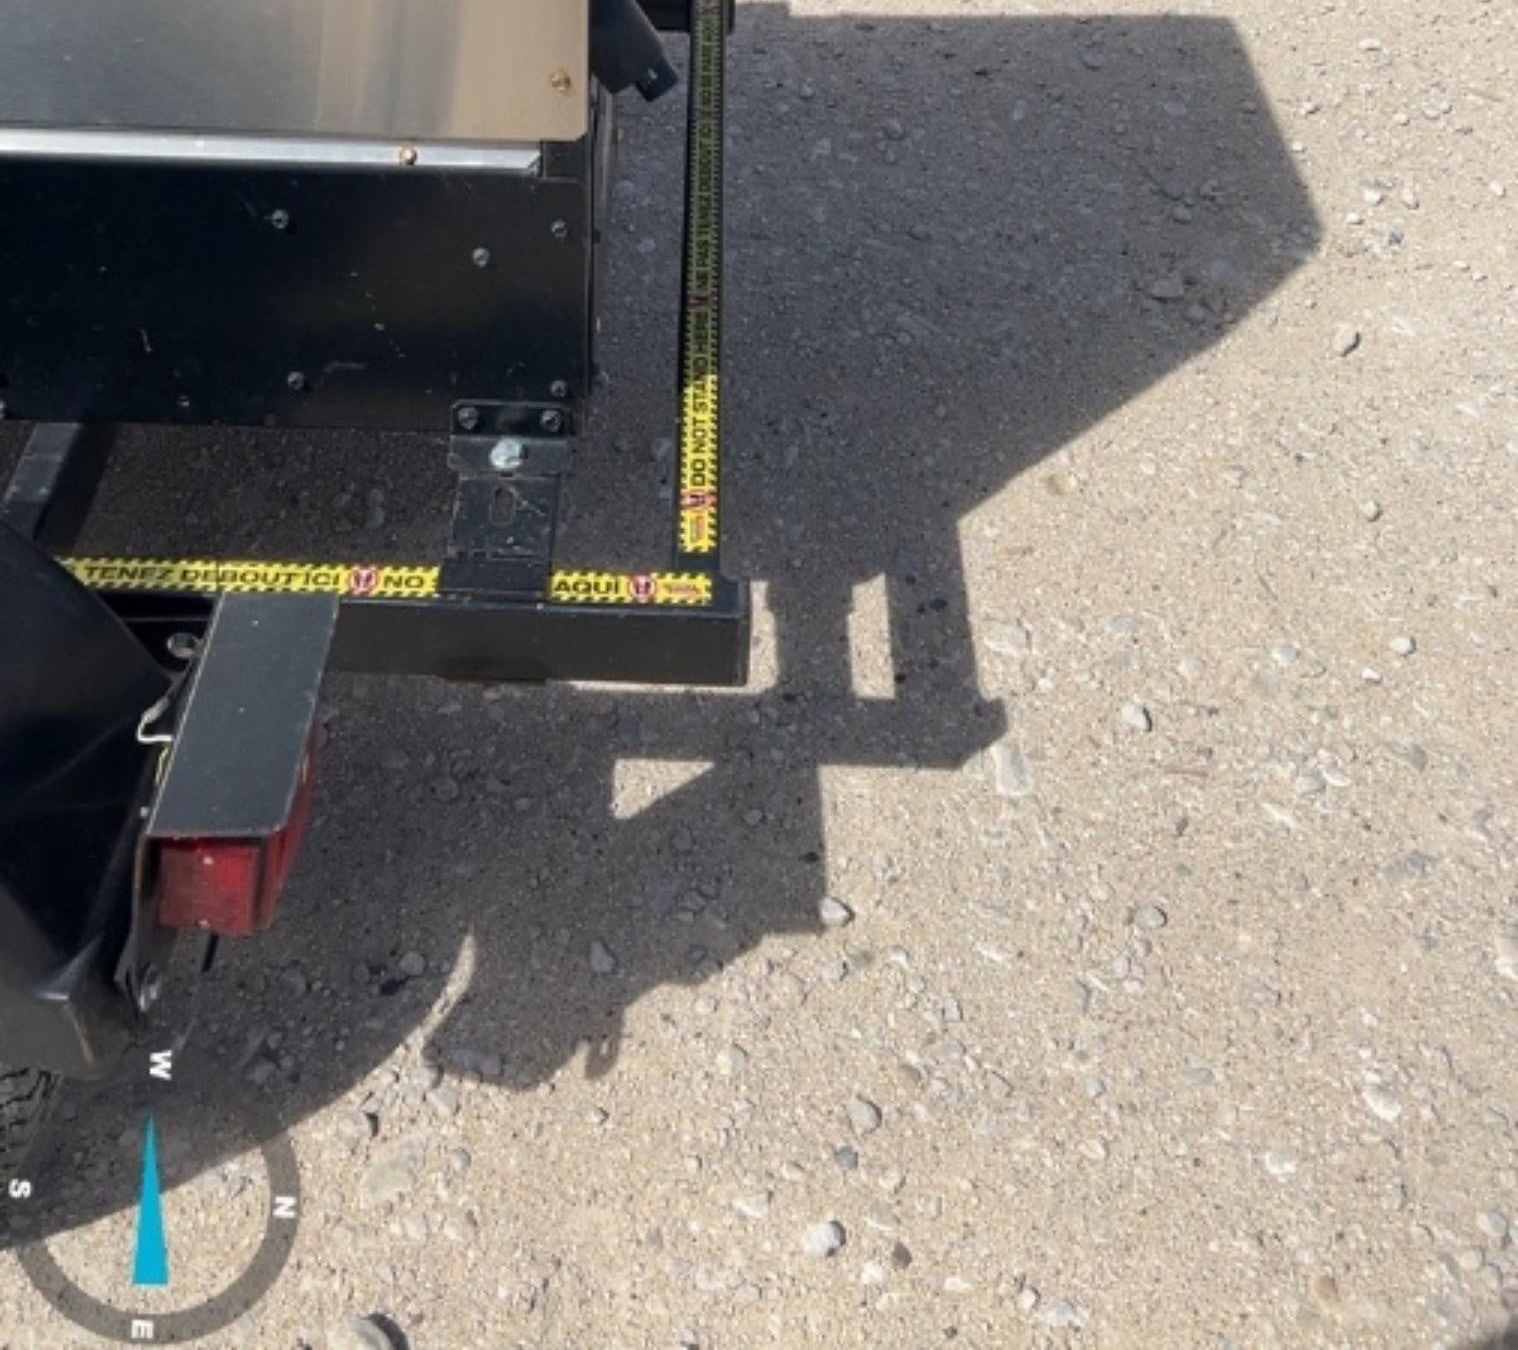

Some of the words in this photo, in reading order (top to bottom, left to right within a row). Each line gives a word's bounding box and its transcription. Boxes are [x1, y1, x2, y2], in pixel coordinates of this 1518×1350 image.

[696, 193, 710, 237] TENEZ
[695, 239, 708, 268] PAS
[694, 310, 708, 355] HERE
[692, 356, 707, 413] STAND
[691, 416, 706, 454] NOT
[690, 458, 706, 486] DO
[84, 565, 174, 581] TENEZ
[179, 568, 298, 586] DEBOUT
[303, 571, 340, 587] ICI
[383, 575, 424, 589] NO
[554, 580, 619, 595] AQUI
